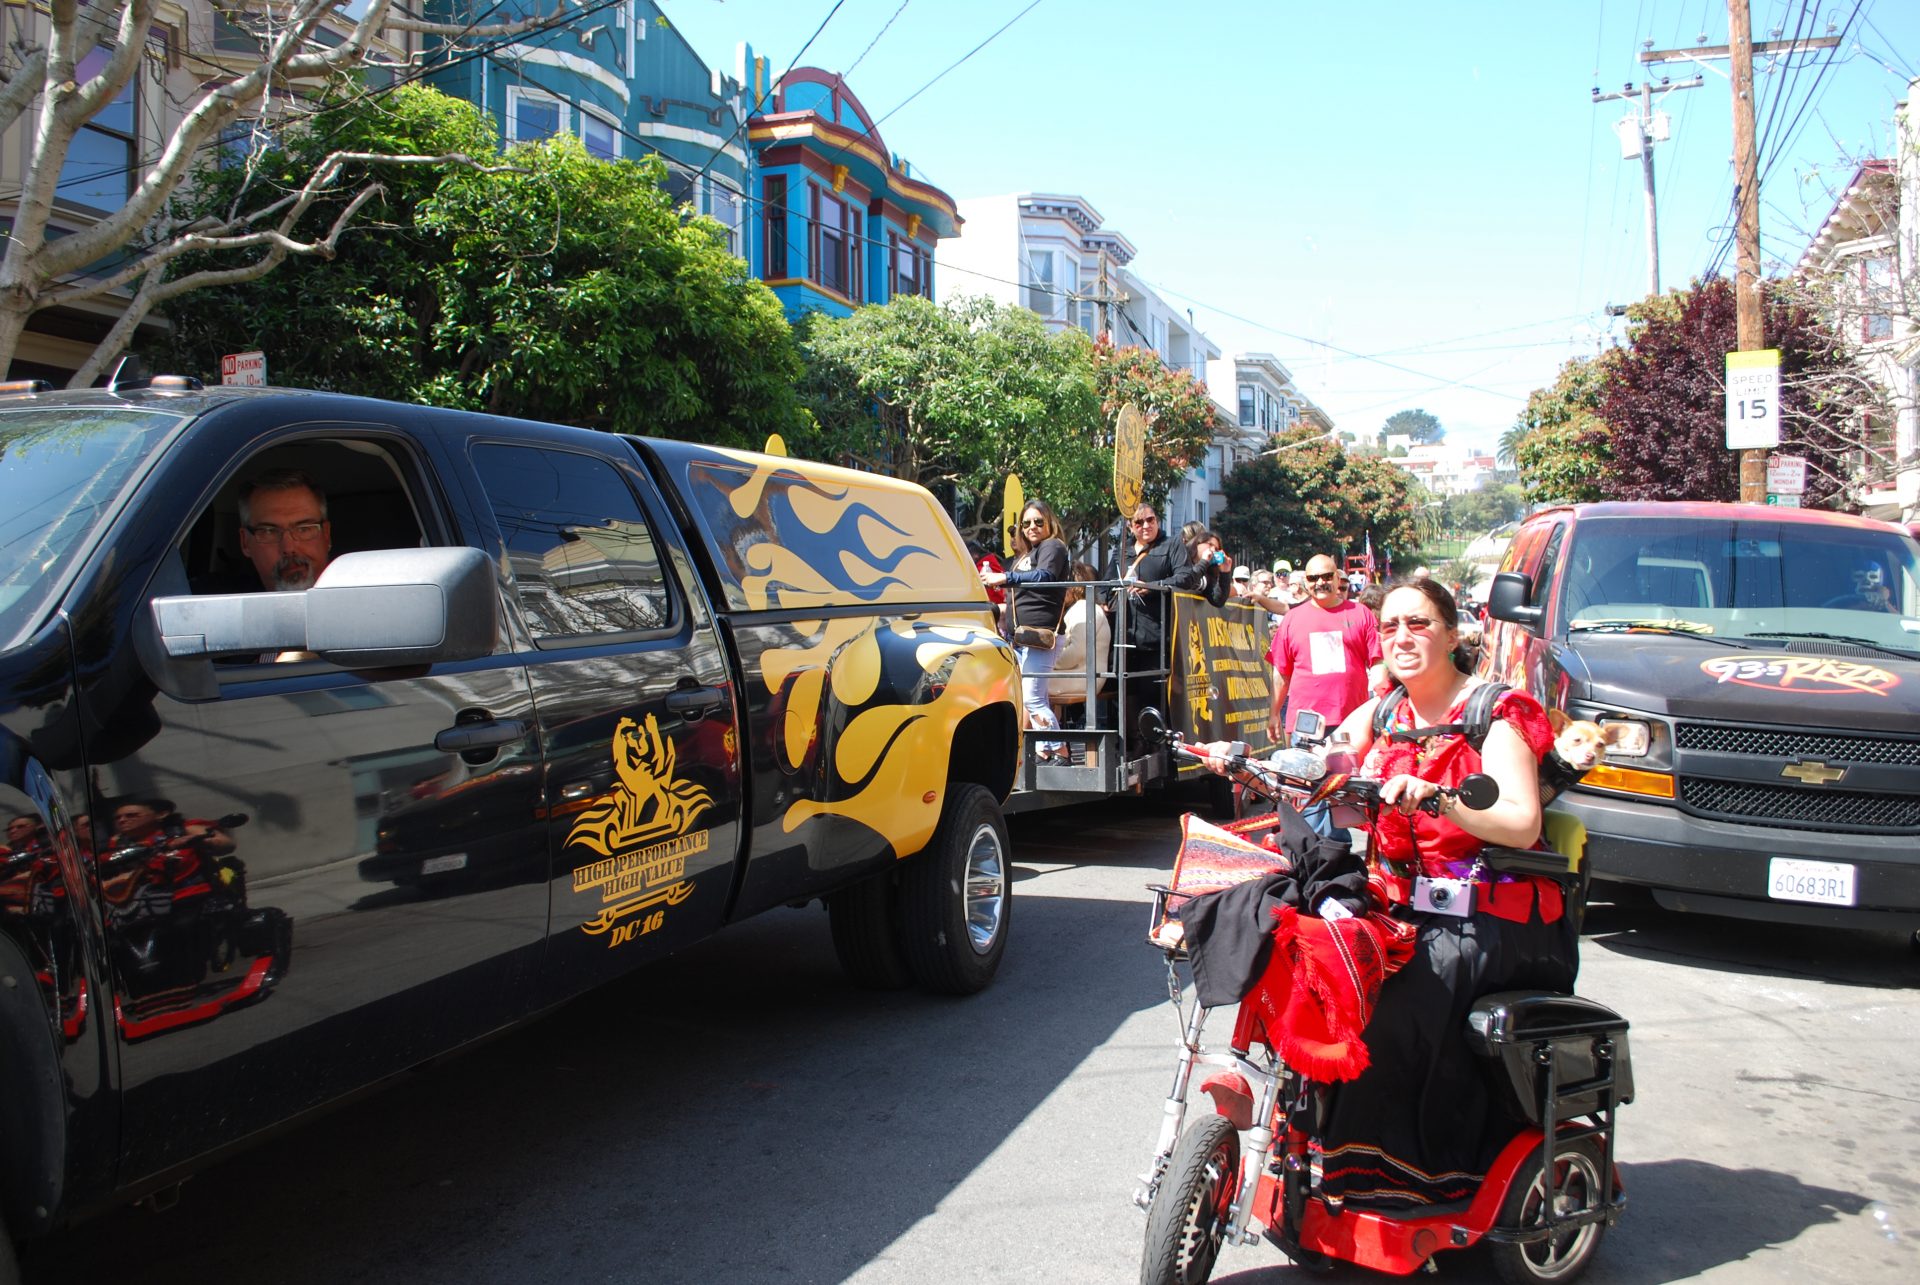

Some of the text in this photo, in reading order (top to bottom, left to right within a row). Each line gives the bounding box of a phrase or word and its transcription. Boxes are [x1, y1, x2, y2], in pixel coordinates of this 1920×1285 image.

[224, 357, 263, 374] NO PARKING
[1732, 374, 1773, 385] SPEED
[1736, 386, 1768, 397] LIMIT
[1738, 399, 1767, 420] 15
[1768, 457, 1803, 468] NO PARKING
[573, 831, 707, 888] HIGH PERFORMANCE
[604, 857, 683, 898] HIGH VALUE
[1775, 874, 1847, 898] 60683R1
